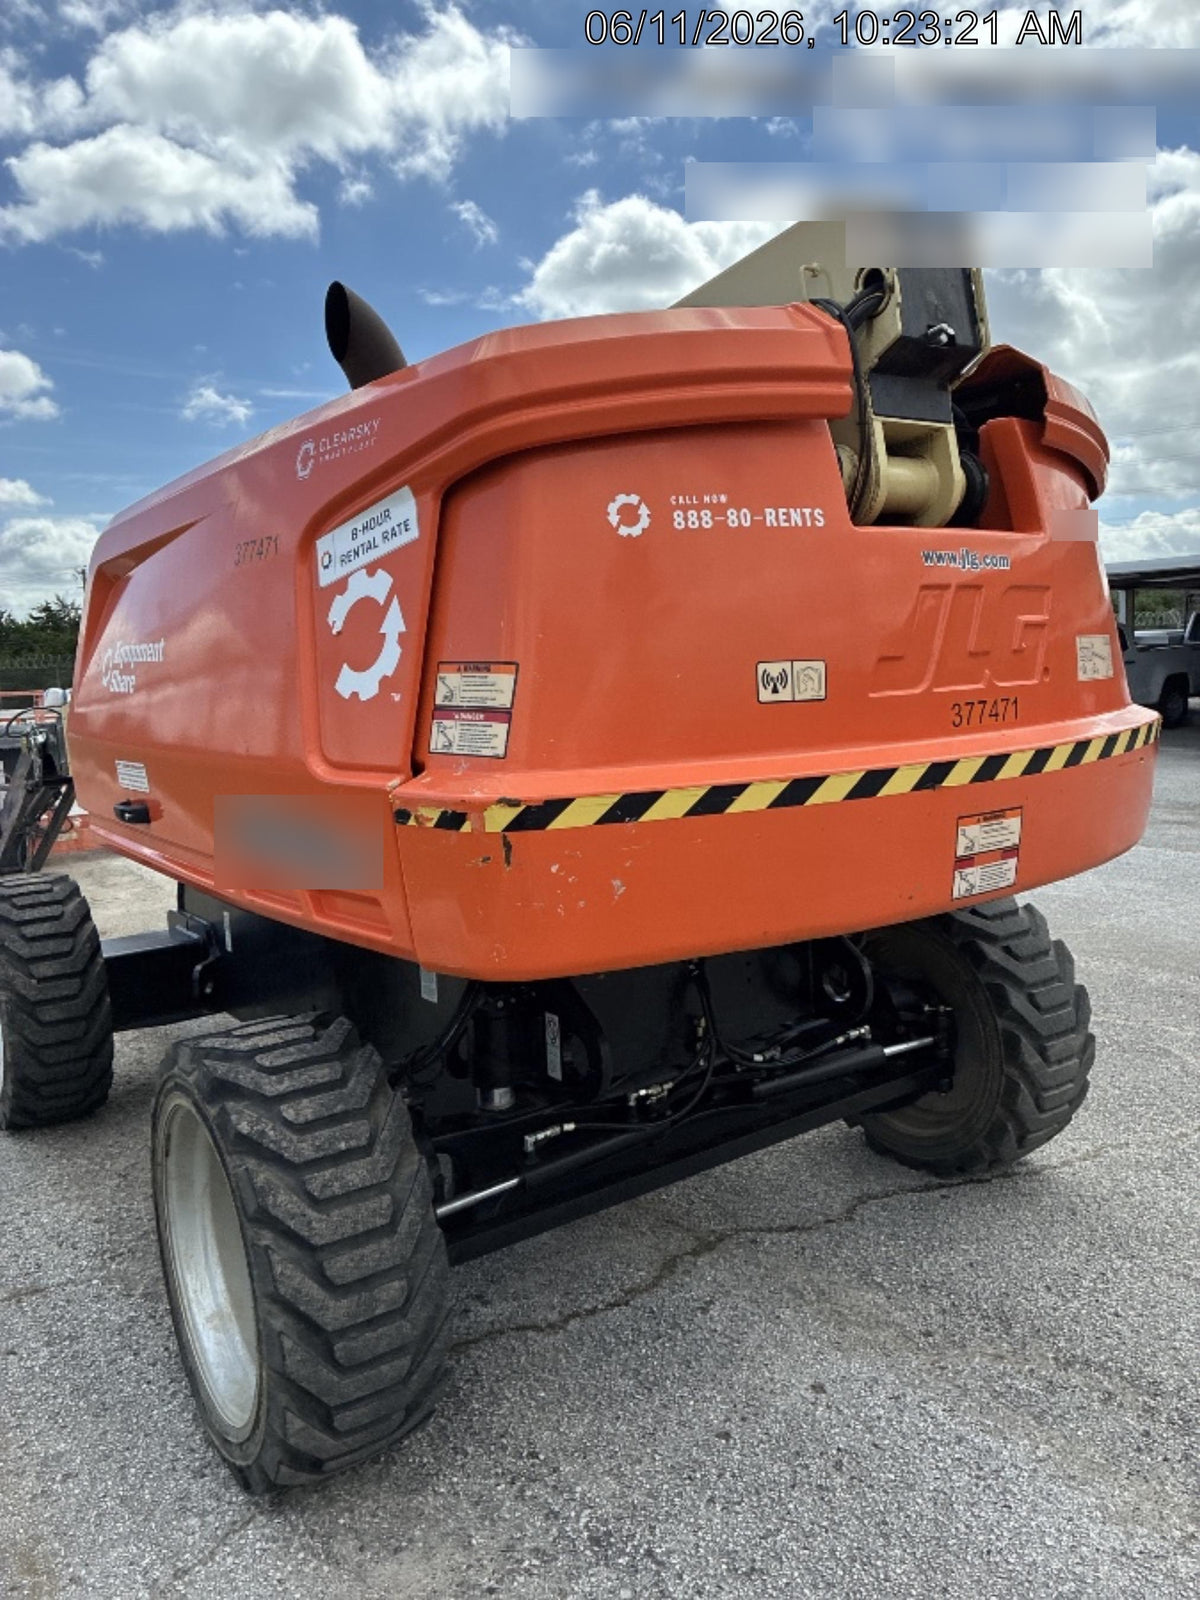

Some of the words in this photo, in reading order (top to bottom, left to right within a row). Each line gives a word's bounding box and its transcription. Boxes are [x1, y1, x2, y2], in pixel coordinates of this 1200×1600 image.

[319, 417, 381, 453] CLEARSKY
[669, 495, 699, 505] CALL
[703, 494, 728, 504] NOW
[351, 508, 392, 541] 8-HOUR
[673, 508, 825, 530] 888-80-RENTS
[234, 533, 280, 567] 377471
[340, 540, 379, 568] RENTAL
[382, 519, 411, 544] RATE
[921, 548, 1011, 571] www.jlg.com
[868, 583, 1052, 699] JLG
[951, 696, 1019, 728] 377471
